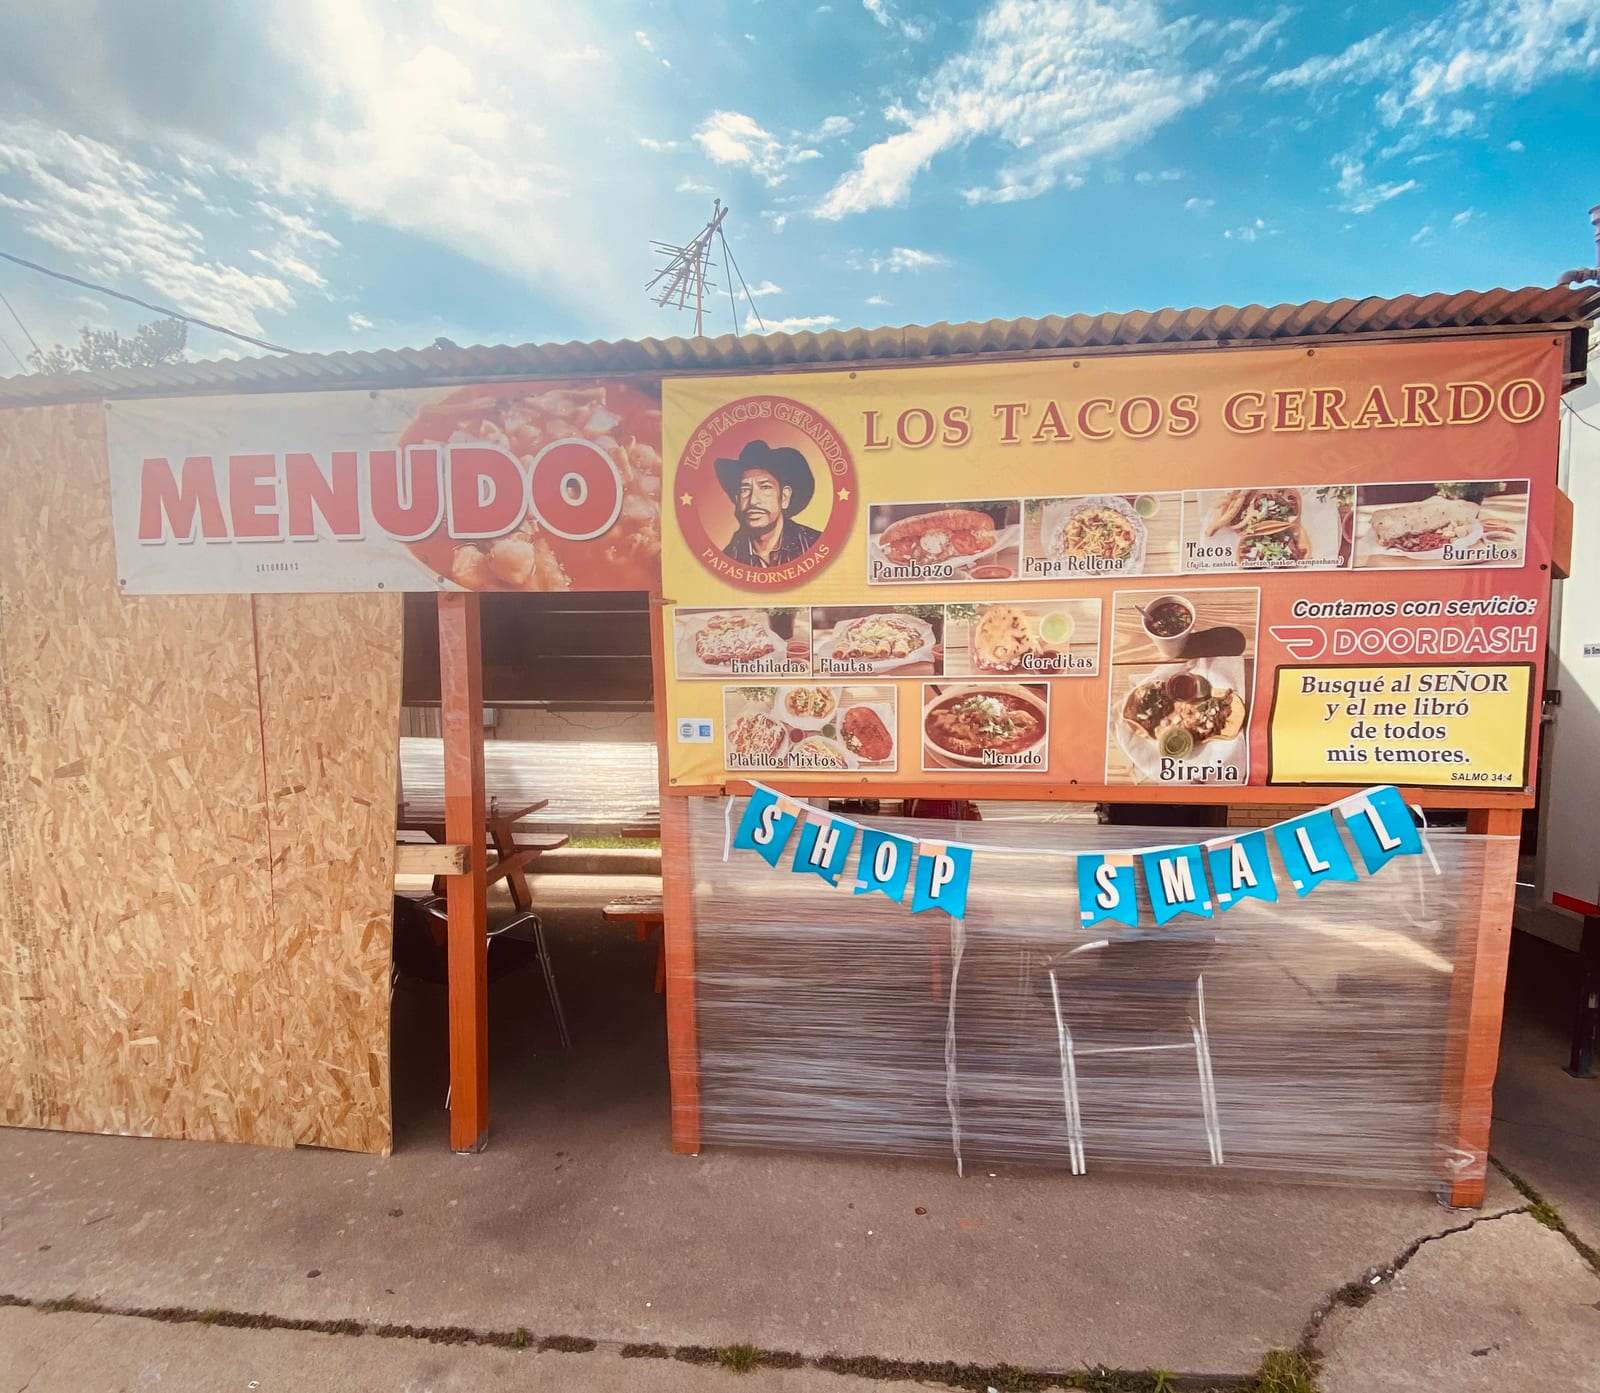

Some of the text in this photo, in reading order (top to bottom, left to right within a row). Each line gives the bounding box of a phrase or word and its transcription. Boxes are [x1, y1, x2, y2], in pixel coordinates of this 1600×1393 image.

[861, 378, 1545, 451] LOS TACOS GERARDO
[684, 401, 848, 476] LOS TACOS GERARDO
[137, 437, 623, 544] MENUDO
[1186, 542, 1232, 557] Tacos
[1443, 543, 1519, 561] Burritos
[702, 543, 830, 584] PAPAS HORNEADAS
[873, 560, 953, 579] Pambazo
[1025, 555, 1124, 575] Papa Rellena
[1292, 595, 1537, 618] Contamos con servicio:
[1333, 626, 1537, 655] DOORDASH
[731, 659, 806, 673] Enchiladas
[820, 658, 874, 673] Flautas
[1022, 653, 1093, 670] Gorditas
[1301, 670, 1508, 698] Busqué al SEÑOR
[1324, 697, 1469, 721] y el me libró
[1350, 721, 1446, 739] de todos
[729, 752, 836, 767] Platillos Mixtos
[983, 749, 1042, 765] Menudo
[1326, 744, 1470, 762] mis temores.
[1158, 757, 1239, 783] Birria
[1450, 772, 1489, 781] SALMO
[753, 804, 1403, 910] SHOP SMALL
